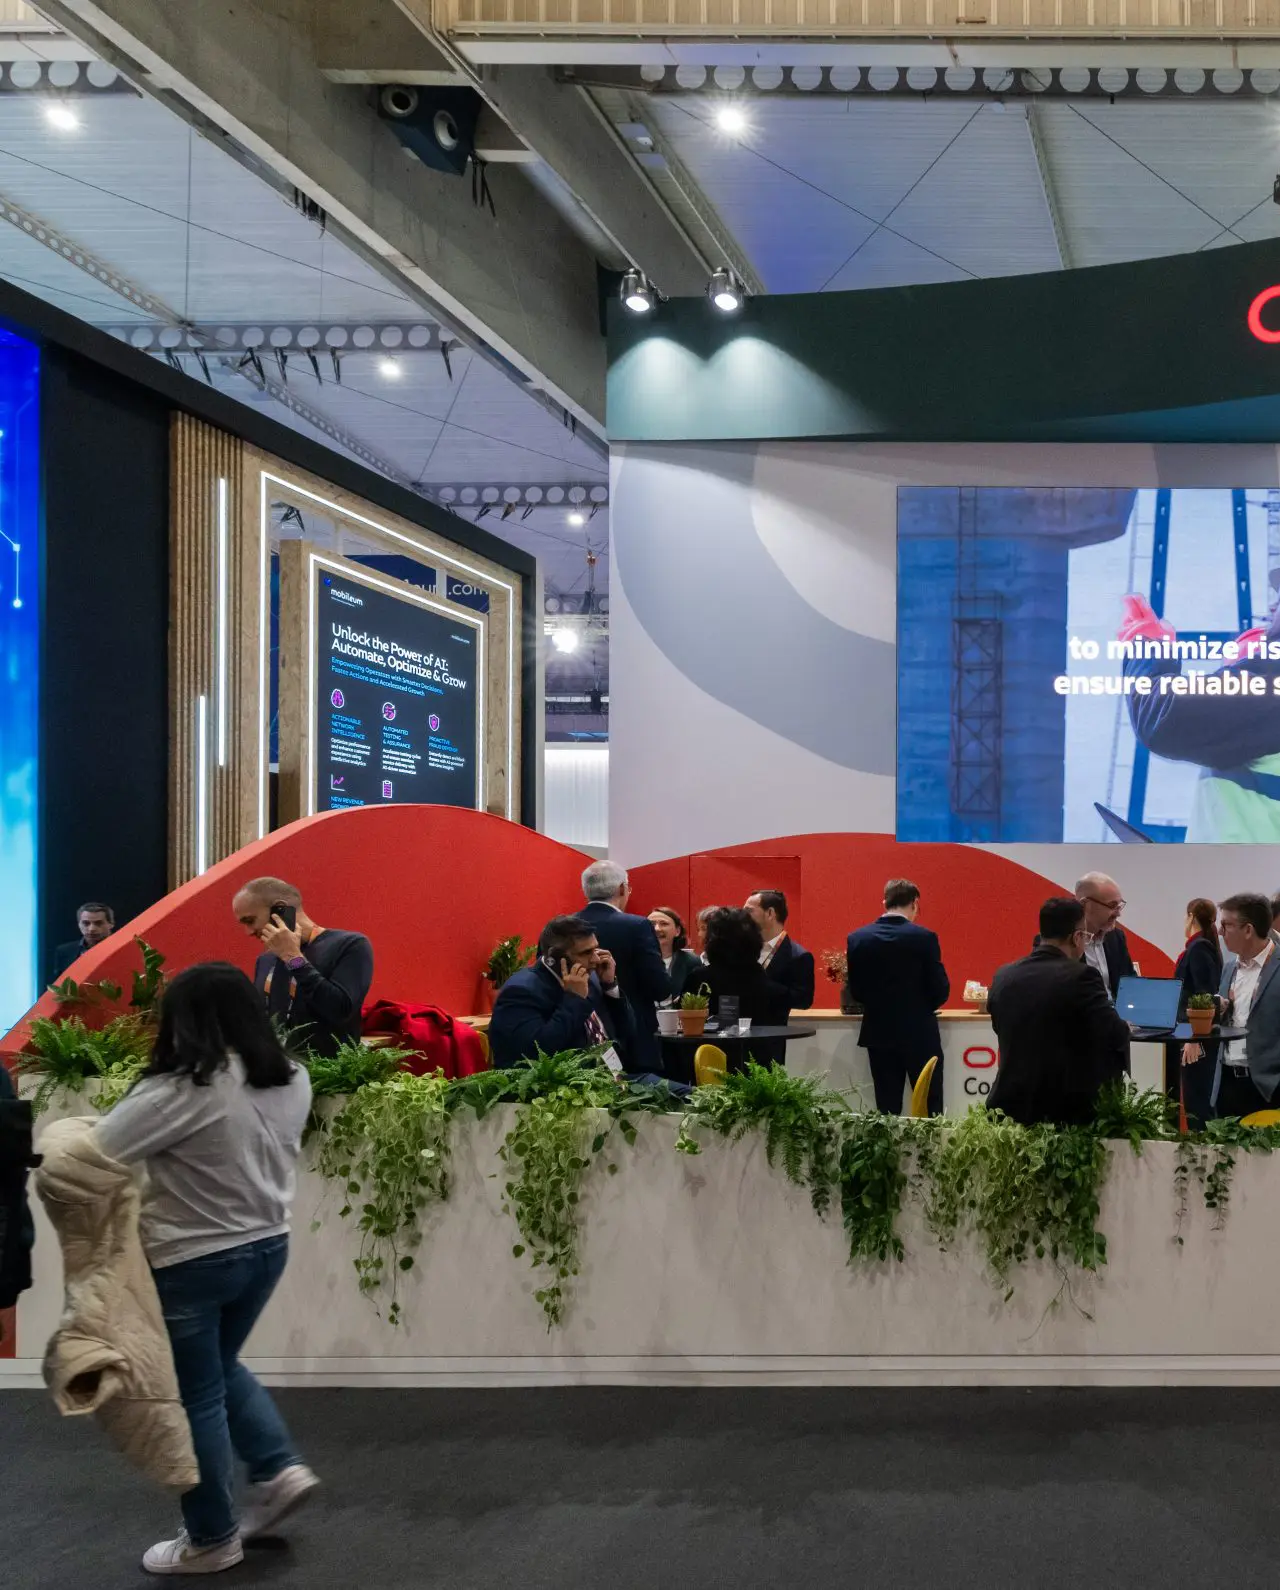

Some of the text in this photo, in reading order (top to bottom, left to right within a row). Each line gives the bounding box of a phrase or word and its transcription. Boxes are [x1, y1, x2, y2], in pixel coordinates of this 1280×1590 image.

[330, 588, 363, 606] mobileum
[332, 622, 449, 671] Unlock the Power of AI:
[1070, 637, 1100, 660] to
[1107, 634, 1239, 660] minimize
[331, 638, 466, 689] Automate, Optimize & Grow
[331, 656, 365, 673] Empowering
[365, 666, 391, 679] Operators
[391, 674, 401, 682] with
[402, 677, 421, 688] Smarter
[331, 665, 349, 676] Faster
[349, 671, 369, 682] Actions
[408, 686, 425, 697] Growth
[1053, 673, 1152, 696] ensure
[1159, 669, 1267, 696] reliable
[343, 797, 365, 805] REVENUE
[963, 1046, 1000, 1068] O
